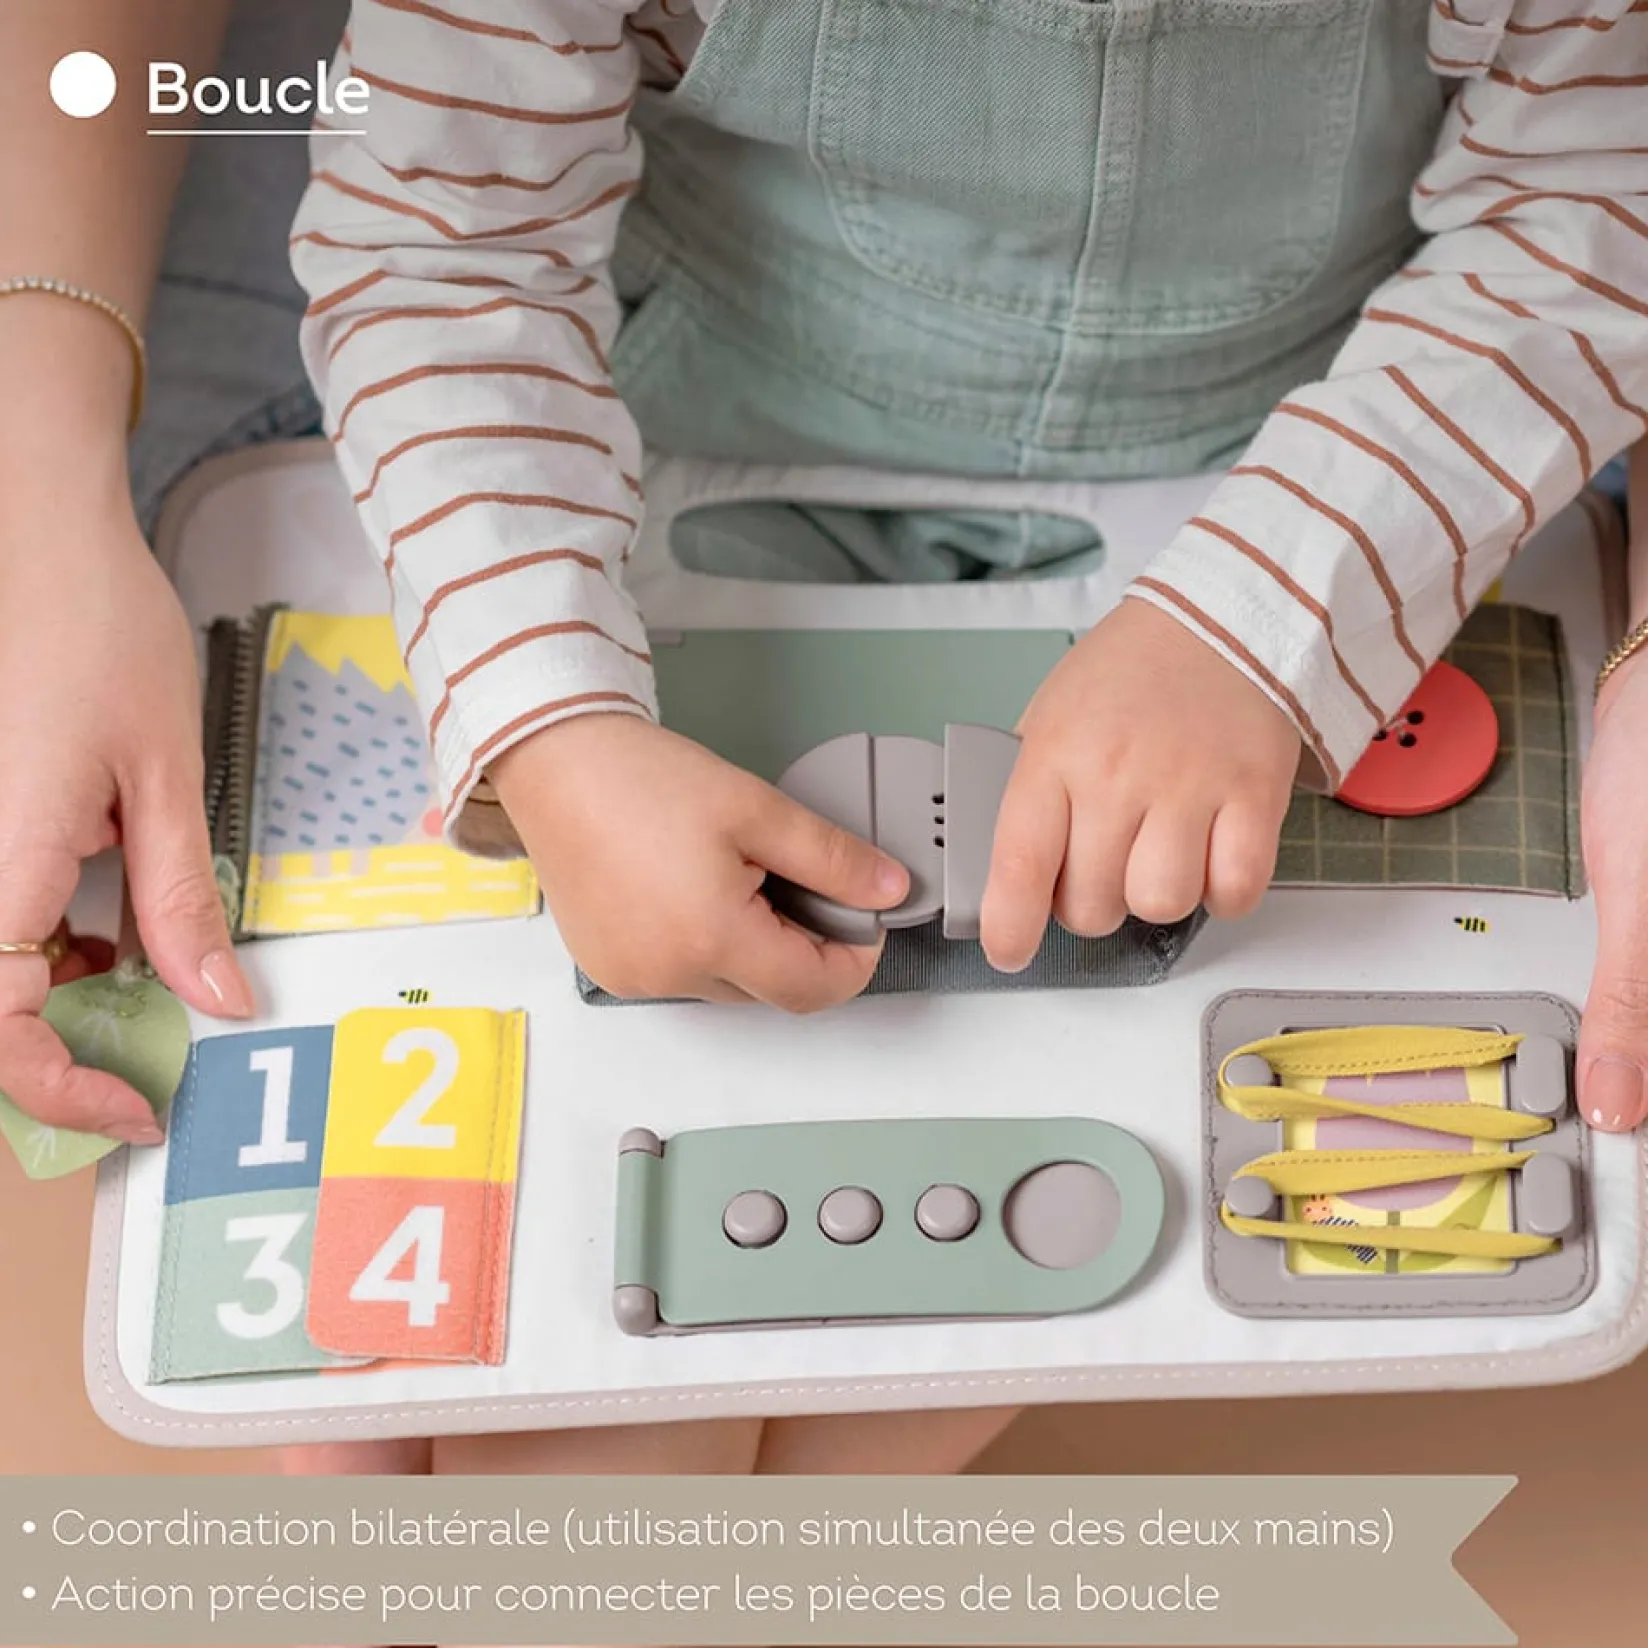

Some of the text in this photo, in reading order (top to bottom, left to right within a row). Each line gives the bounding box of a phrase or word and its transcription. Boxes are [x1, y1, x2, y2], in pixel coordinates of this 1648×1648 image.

[238, 1046, 308, 1168] 1
[373, 1027, 459, 1149] 2
[216, 1212, 308, 1340] 3
[349, 1205, 450, 1327] 4
